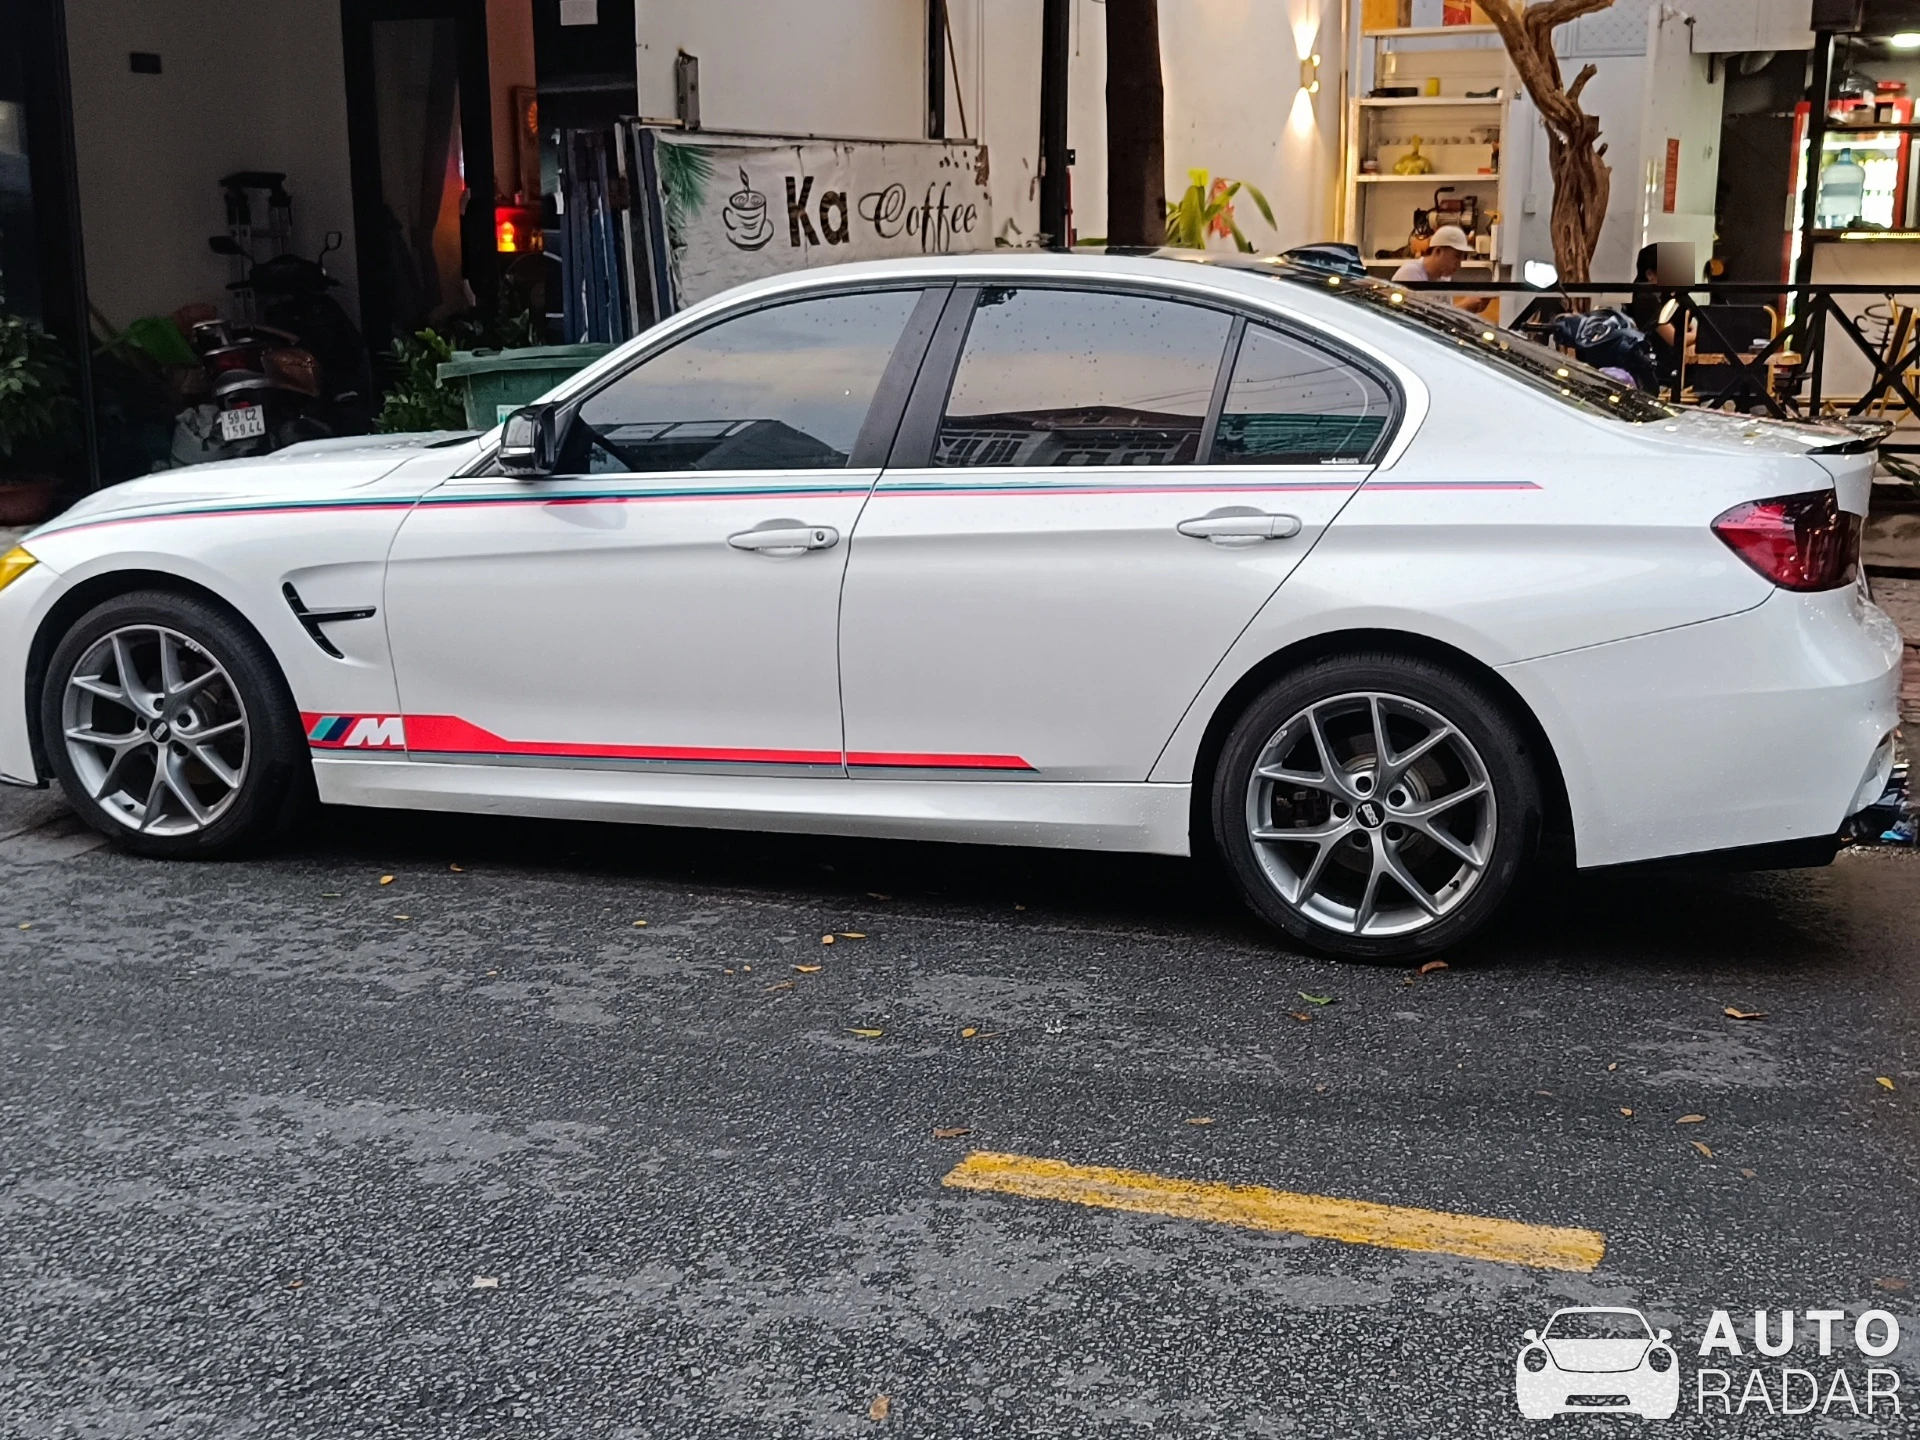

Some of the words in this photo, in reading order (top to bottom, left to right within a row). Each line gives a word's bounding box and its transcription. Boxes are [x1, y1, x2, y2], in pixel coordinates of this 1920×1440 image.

[785, 176, 850, 247] Ka
[857, 181, 978, 253] Coffee
[343, 717, 405, 747] M
